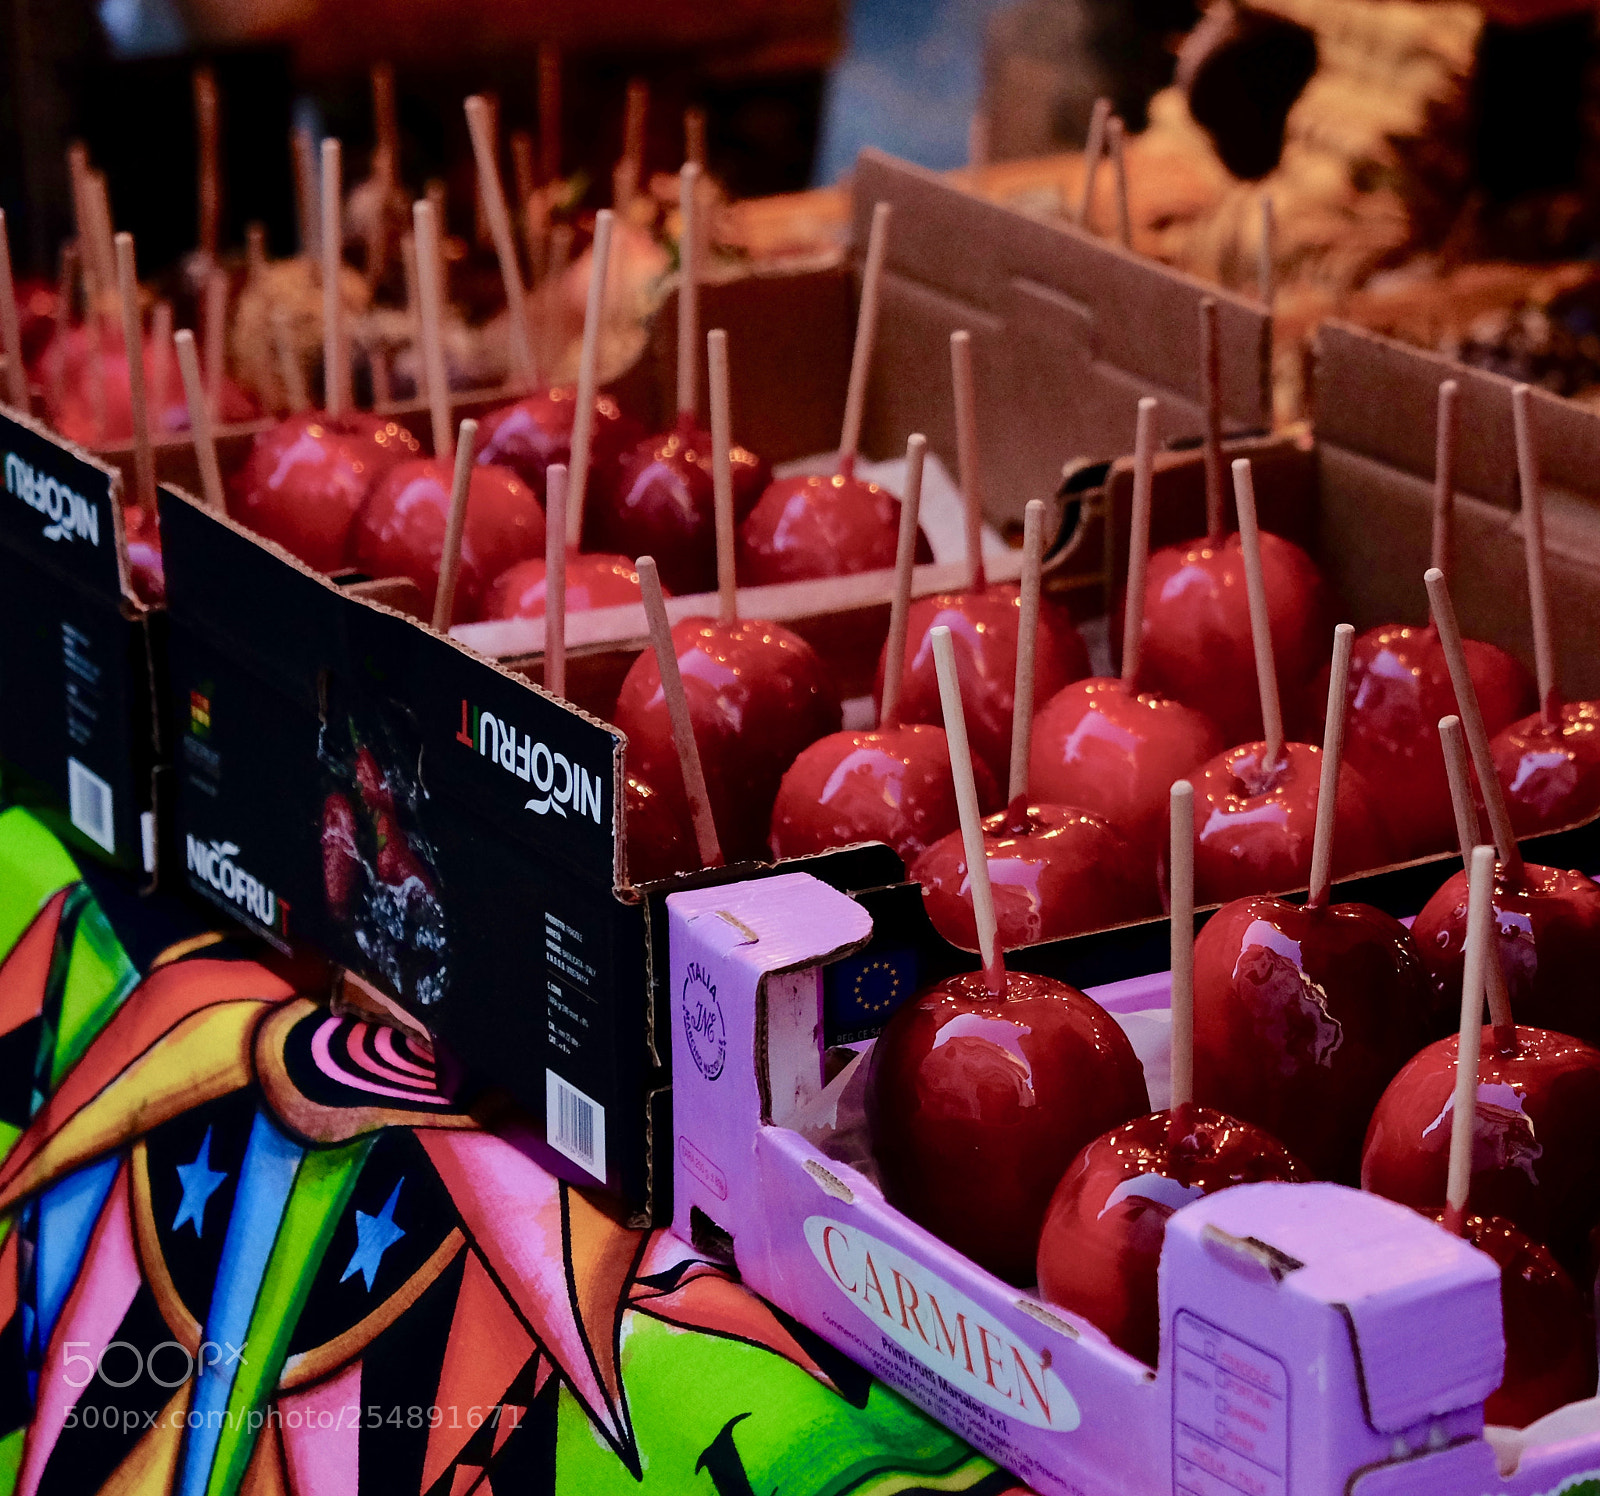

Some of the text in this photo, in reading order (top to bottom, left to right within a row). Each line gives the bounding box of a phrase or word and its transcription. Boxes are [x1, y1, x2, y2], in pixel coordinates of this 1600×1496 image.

[456, 700, 601, 824] NICOFRUIT
[688, 961, 718, 1003] ITALIA
[823, 1226, 1052, 1425] CARMEN
[881, 1336, 1010, 1437] Primi Frutti Marsalesi s.r.l.
